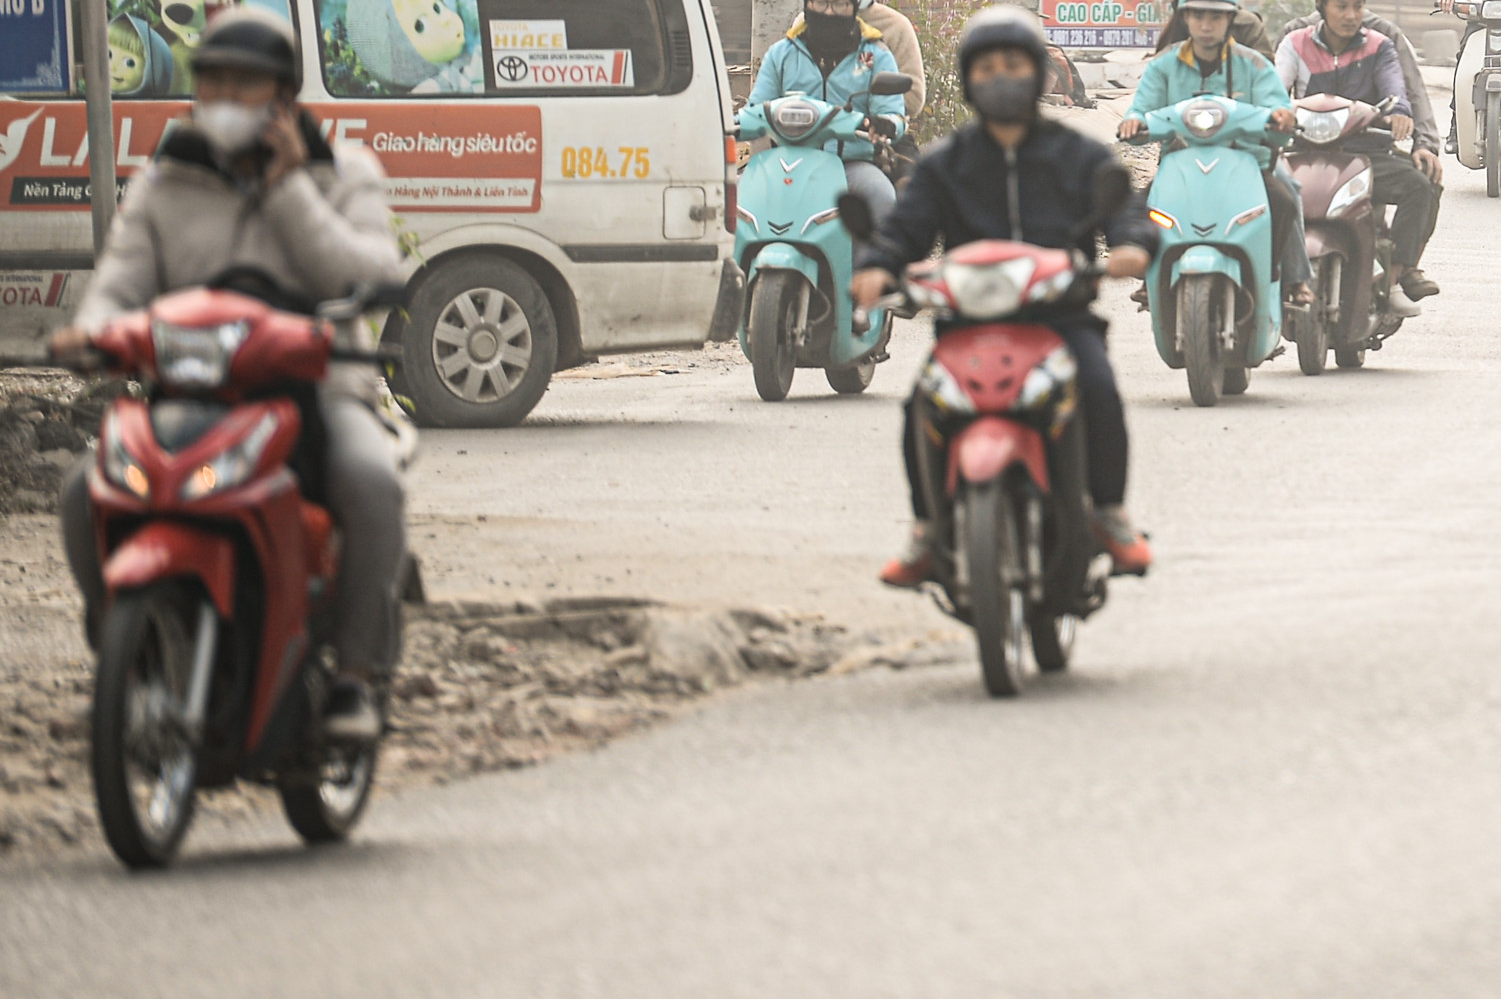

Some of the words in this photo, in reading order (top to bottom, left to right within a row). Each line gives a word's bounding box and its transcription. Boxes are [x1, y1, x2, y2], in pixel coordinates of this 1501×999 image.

[1057, 3, 1087, 23] CAO
[494, 34, 563, 48] HIACE
[530, 66, 608, 83] TOYOTA
[373, 132, 415, 152] Giao
[417, 132, 464, 158] hàng
[466, 133, 504, 152] siêu
[506, 131, 537, 152] tốc
[561, 147, 650, 179] 084.75
[24, 182, 49, 197] Nền
[52, 181, 82, 200] Tảng
[423, 185, 439, 199] Nội
[441, 185, 473, 197] Thành
[0, 286, 43, 306] OTA
